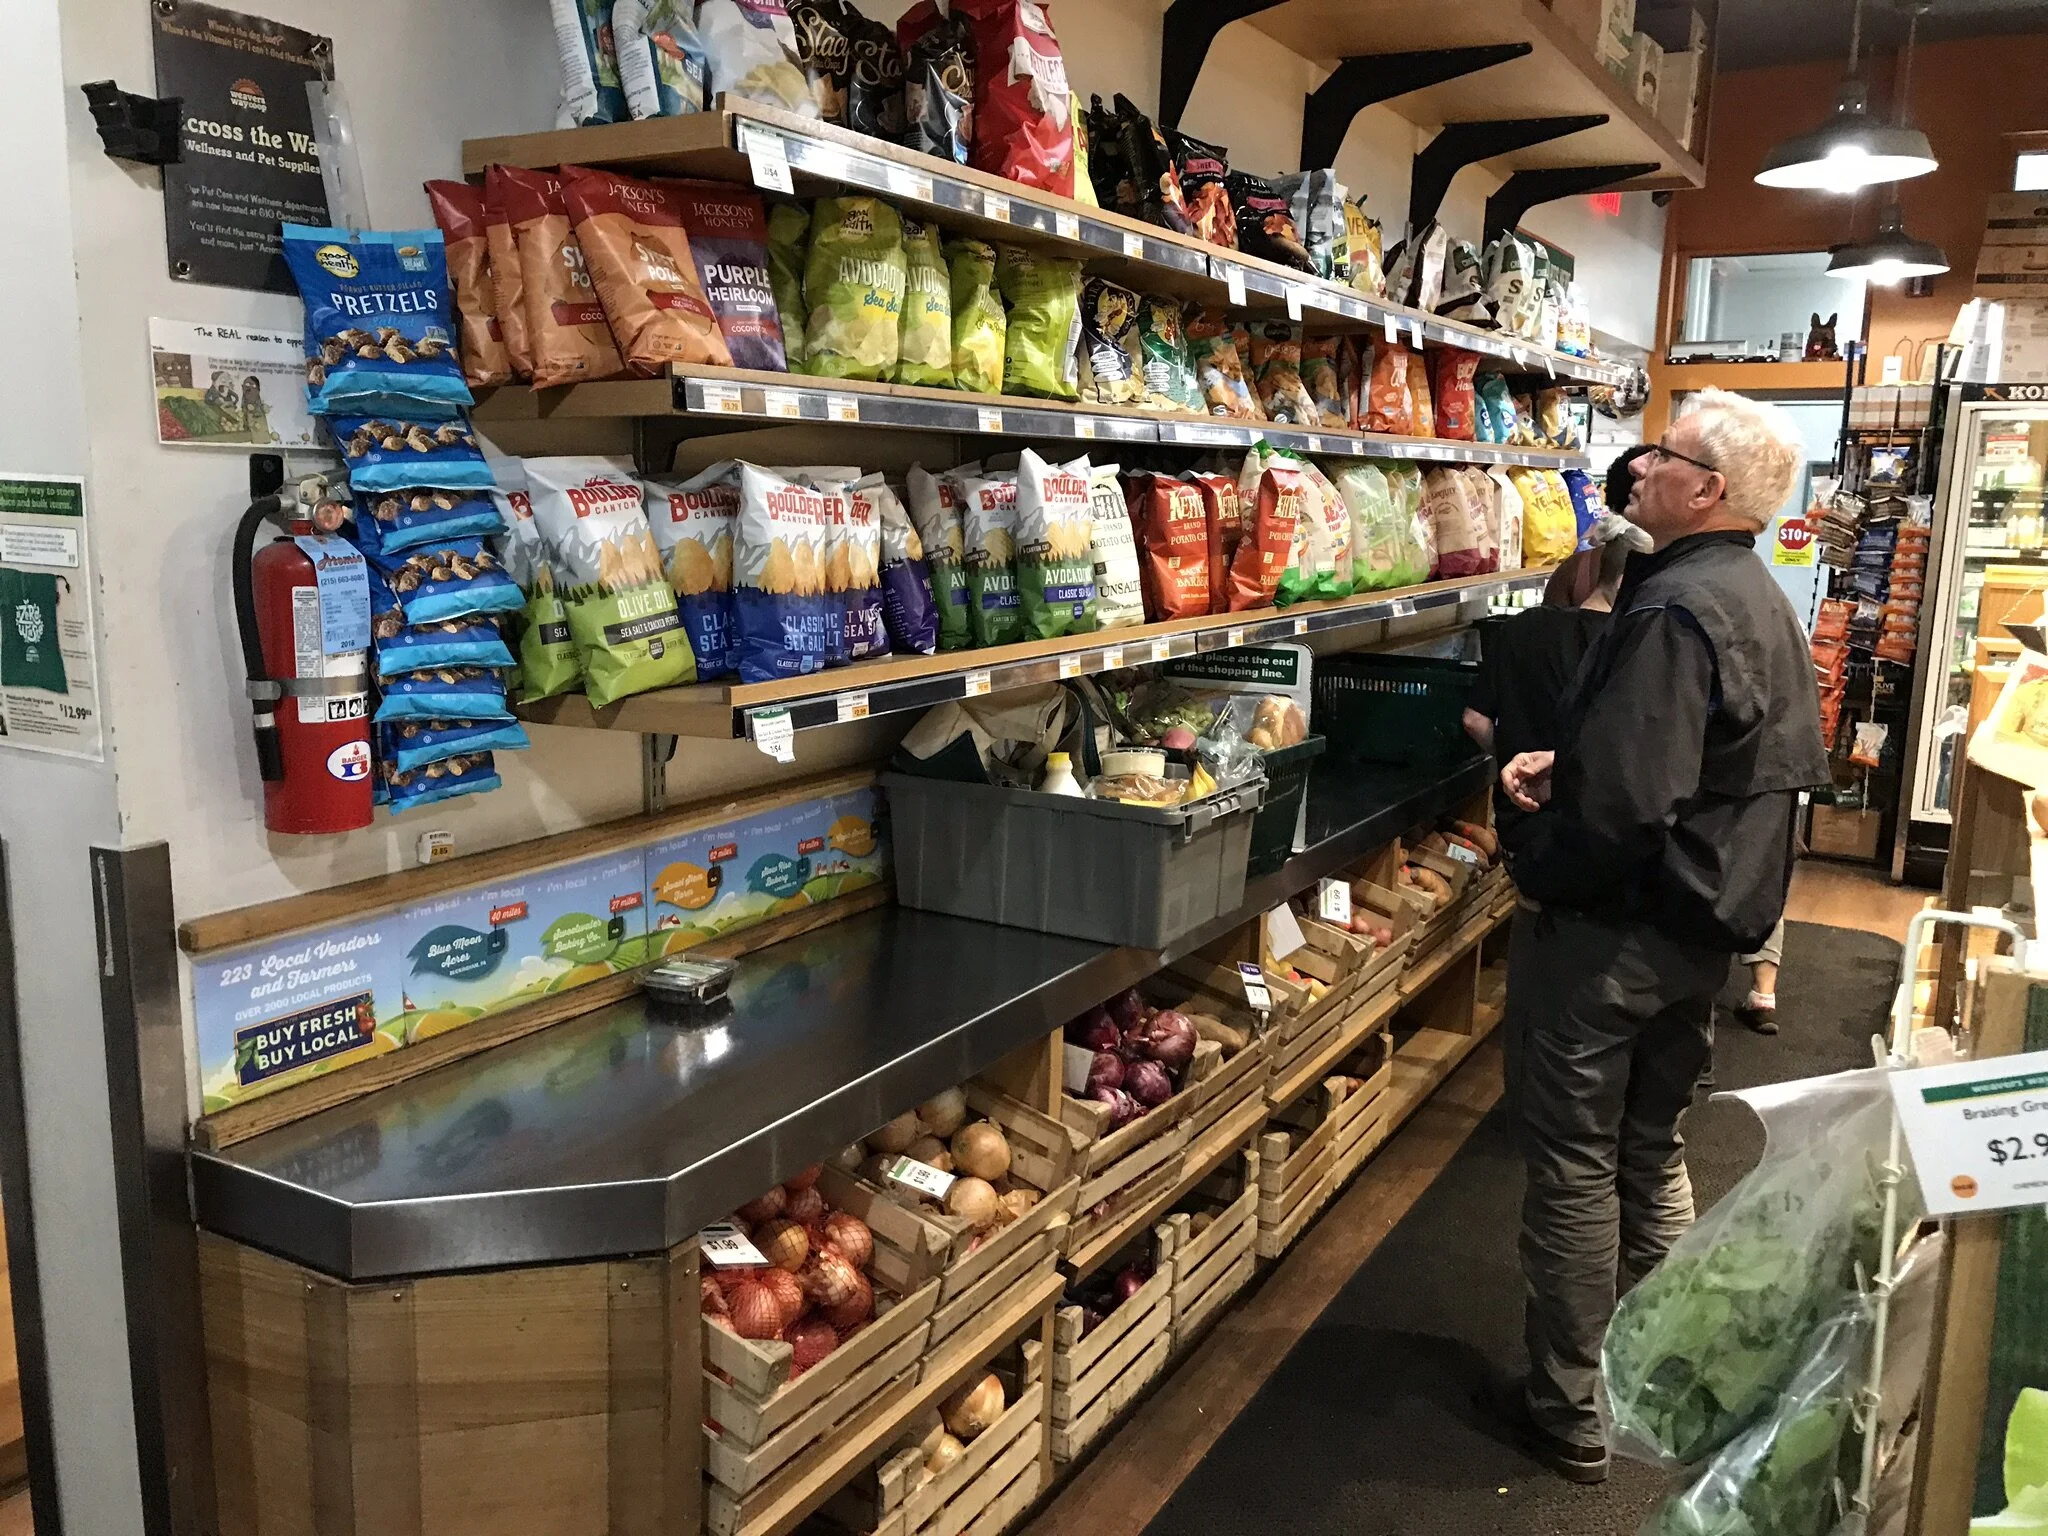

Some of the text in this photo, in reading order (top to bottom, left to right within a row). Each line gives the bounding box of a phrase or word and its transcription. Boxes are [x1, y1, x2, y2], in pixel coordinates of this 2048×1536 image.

[796, 7, 849, 75] Stacy
[230, 90, 266, 104] weavers
[182, 117, 319, 157] cross the Wa
[184, 139, 320, 175] Wellness and Pet Supplies
[223, 203, 248, 215] located
[693, 203, 753, 221] JACKSON'S
[704, 217, 750, 229] HONEST
[200, 237, 215, 246] and
[319, 251, 351, 260] good
[321, 259, 358, 271] health
[704, 264, 770, 288] PURPLE
[331, 290, 437, 315] PRETZELS
[707, 287, 774, 306] HEIRLOOM
[864, 291, 885, 308] Sea
[194, 327, 212, 337] The
[217, 327, 241, 340] REAL
[274, 335, 282, 344] to
[286, 338, 304, 348] oppo
[2008, 386, 2048, 400] KO
[30, 488, 44, 498] way
[56, 488, 75, 497] store
[1043, 479, 1089, 504] BOULDER
[595, 500, 639, 515] CANYON
[766, 491, 824, 526] BOULDER
[781, 514, 812, 525] CANYON
[1171, 534, 1196, 545] POTATO
[1780, 528, 1810, 540] STOP
[1090, 537, 1119, 549] POTATO
[316, 552, 363, 571] Atomic
[321, 577, 337, 587] (215)
[983, 575, 1017, 592] AVOC
[1045, 568, 1084, 585] AVOCADO
[1000, 594, 1021, 606] CLASS
[1058, 588, 1077, 599] CLASSIC
[617, 589, 673, 618] OLIVE OIL
[621, 627, 632, 638] SEA
[632, 625, 643, 635] SALT
[648, 619, 665, 631] CRACKED
[786, 615, 824, 633] CLASSIC
[844, 625, 864, 638] SEA
[554, 627, 568, 638] SEA
[701, 635, 727, 653] SEA
[784, 634, 825, 651] SEA SALT
[1205, 652, 1293, 666] place at the end
[1188, 663, 1205, 672] the
[1208, 664, 1258, 678] shopping
[1261, 668, 1285, 678] line.
[60, 703, 86, 720] $12.99
[341, 755, 368, 763] BADGER
[716, 830, 736, 840] local
[765, 822, 782, 834] local
[669, 838, 688, 852] local
[619, 856, 640, 873] local
[565, 876, 588, 889] local
[500, 886, 525, 899] local
[435, 898, 460, 912] local
[620, 896, 638, 907] miles
[491, 907, 521, 922] 40 miles
[427, 934, 483, 959] Blue Moon
[555, 937, 584, 953] Baking
[220, 932, 382, 987] 223 Local Vendors
[441, 952, 470, 969] Acres
[251, 957, 358, 999] and Farmers
[235, 1004, 261, 1022] OVER
[264, 999, 289, 1013] 2000
[291, 990, 322, 1006] LOCAL
[324, 973, 373, 996] PRODUCTS
[257, 1025, 295, 1050] BUY
[300, 1005, 357, 1036] FRESH
[258, 1046, 296, 1071] BUY
[302, 1026, 363, 1057] LOCAL.
[1962, 1100, 2048, 1120] Braising Gre
[707, 1240, 738, 1250] $1.99
